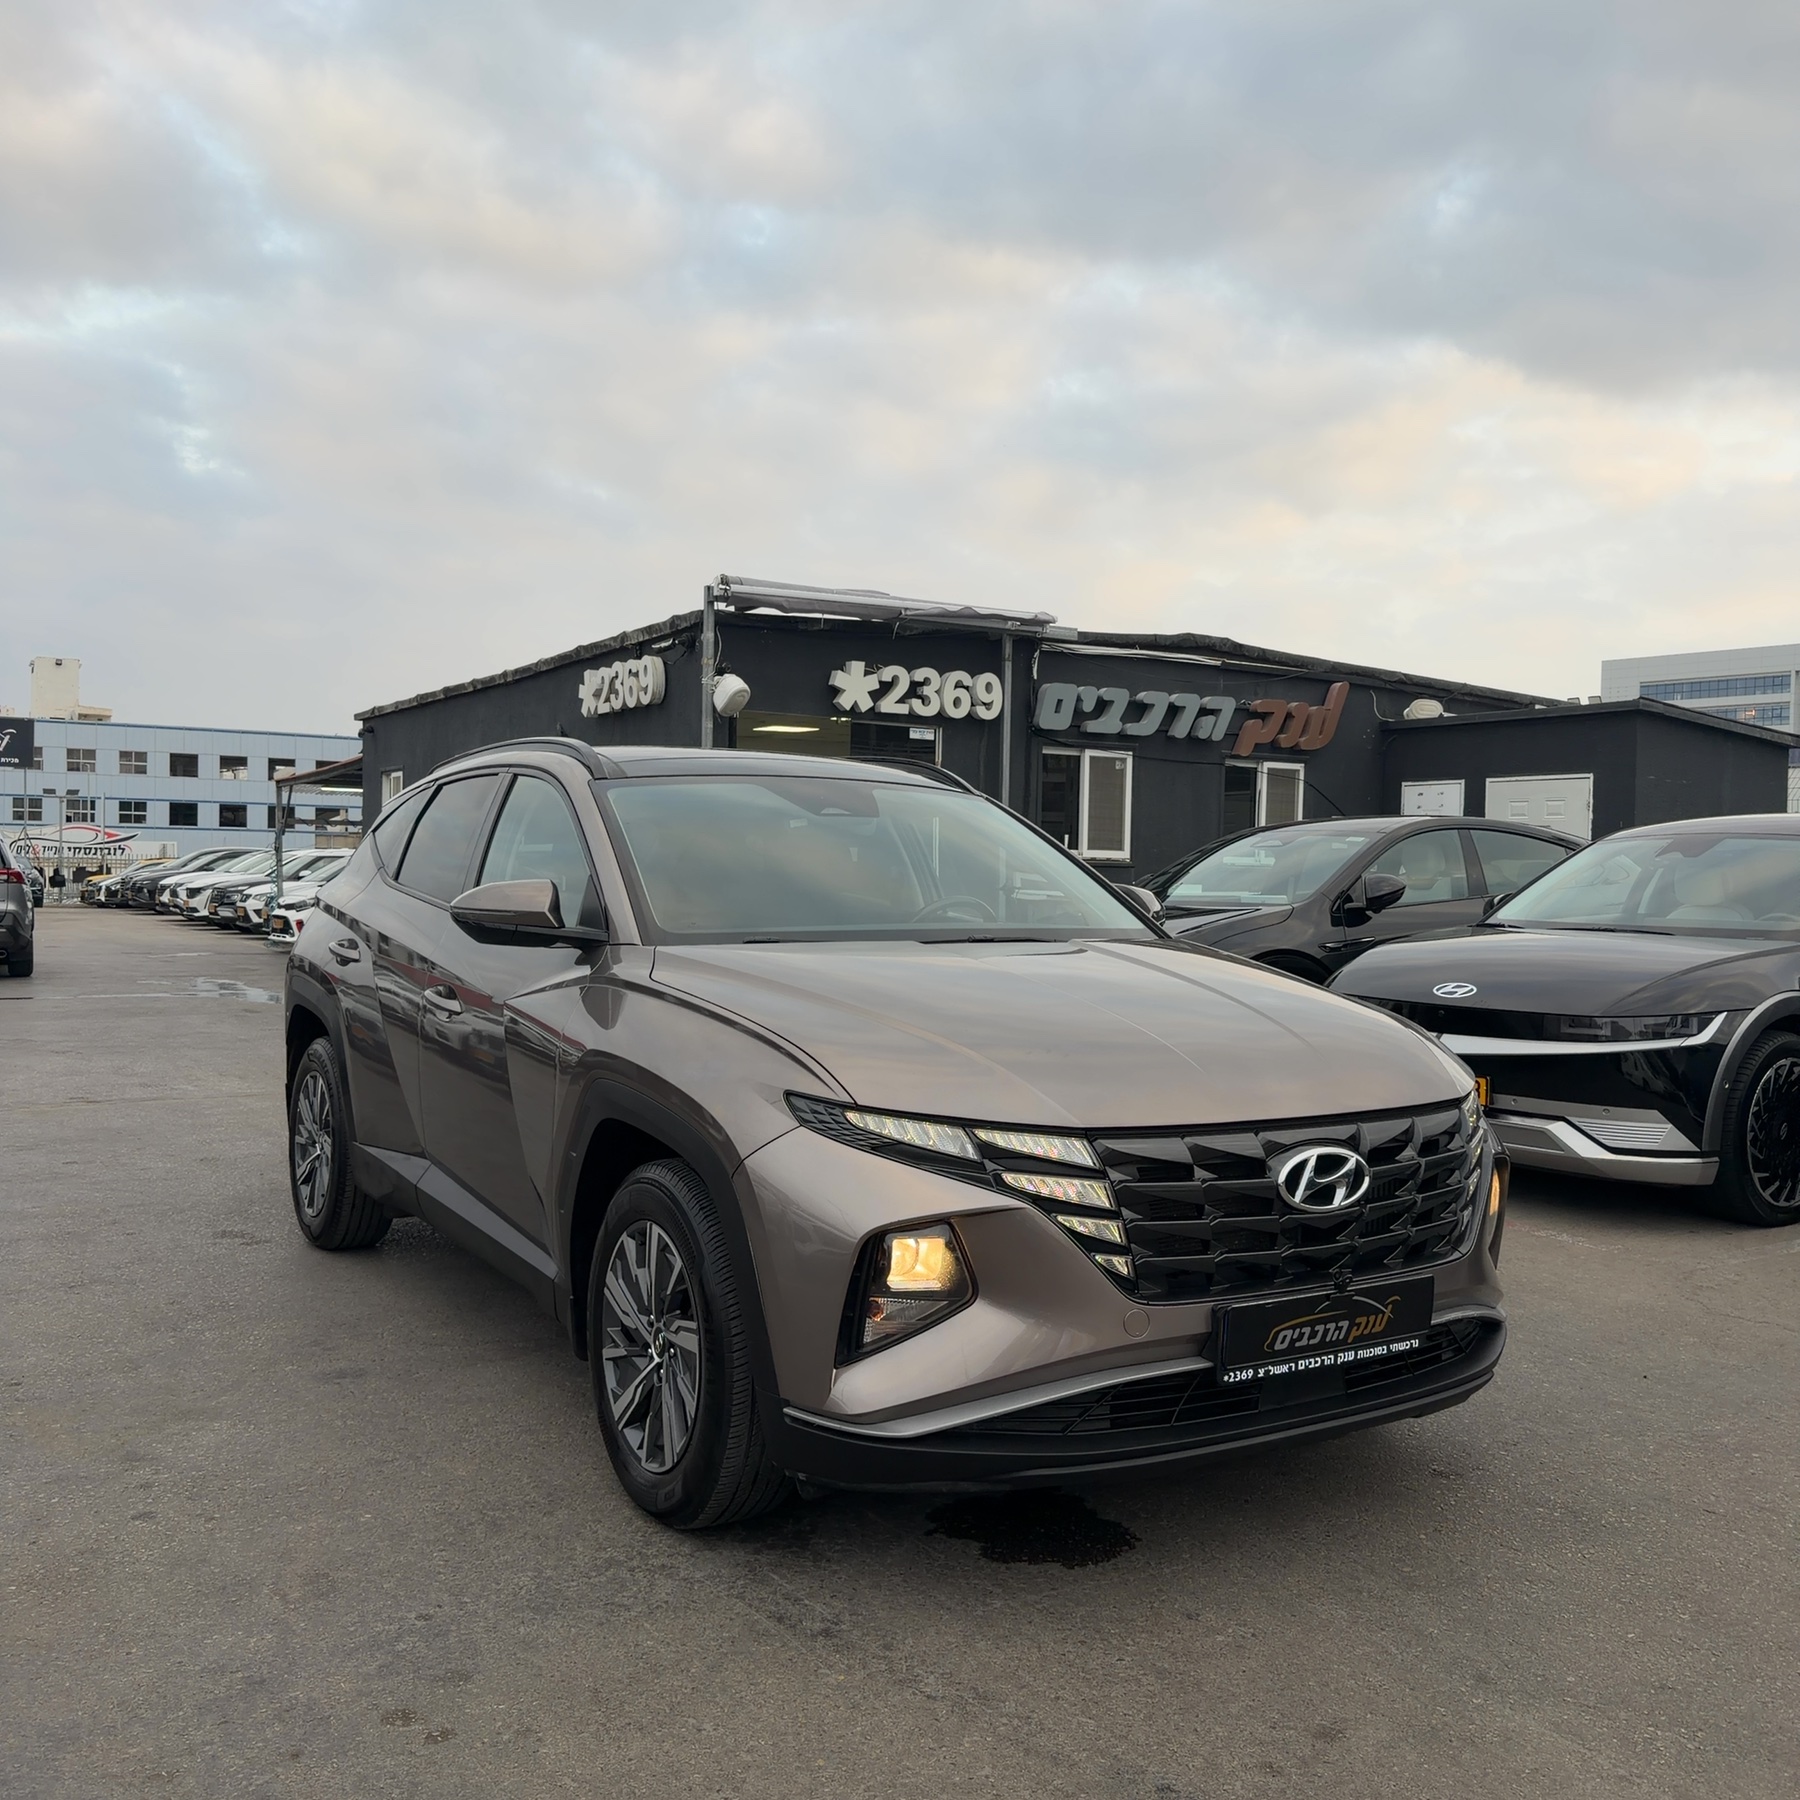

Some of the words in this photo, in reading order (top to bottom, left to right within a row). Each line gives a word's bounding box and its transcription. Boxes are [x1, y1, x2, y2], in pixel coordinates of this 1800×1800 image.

[1033, 682, 1236, 741] הרכבים
[1231, 681, 1349, 757] ענק
[1347, 1304, 1393, 1343] ענק
[1274, 1320, 1349, 1350] הרכבים
[1389, 1339, 1419, 1352] נרכשתי
[1298, 1355, 1334, 1370] הרכבים
[1337, 1351, 1354, 1365] ענק
[1357, 1345, 1387, 1359] בסוכנות
